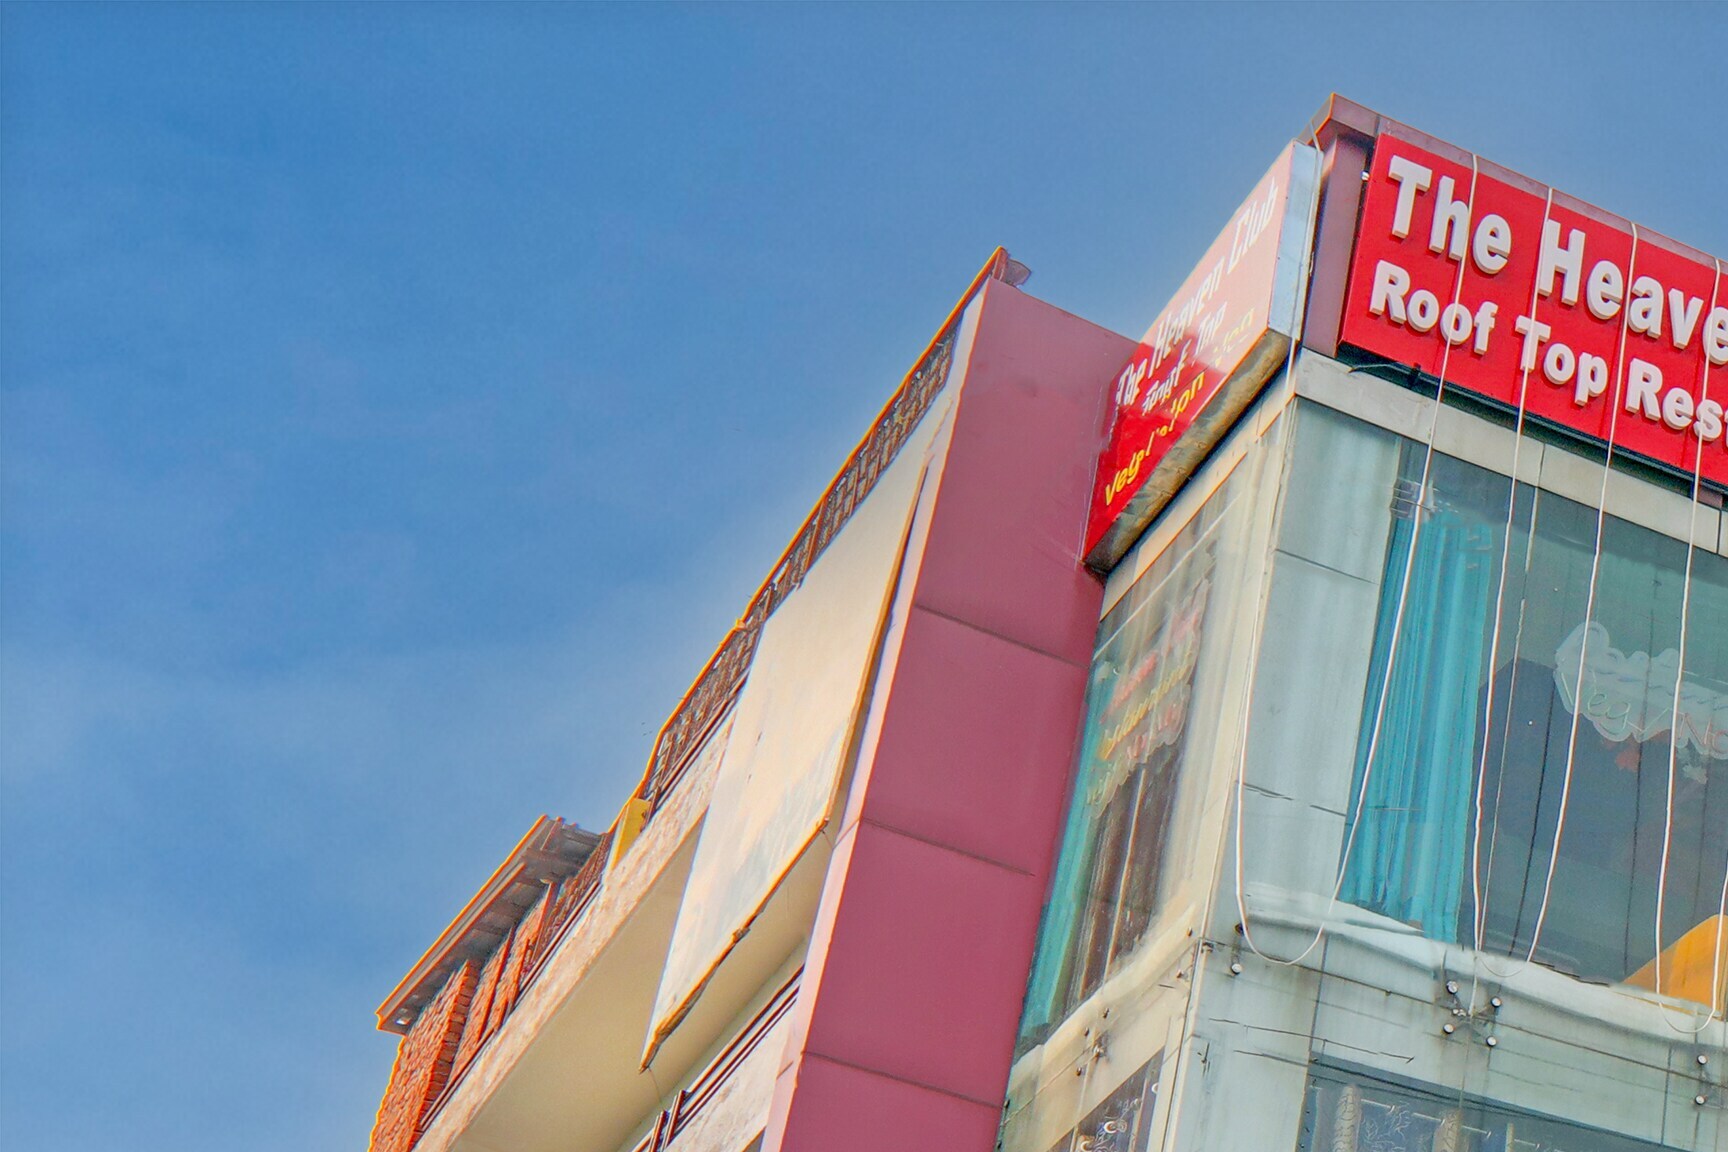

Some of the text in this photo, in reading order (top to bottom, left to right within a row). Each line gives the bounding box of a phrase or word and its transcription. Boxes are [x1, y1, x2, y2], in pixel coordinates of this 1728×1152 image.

[1388, 155, 1511, 274] The
[1370, 260, 1498, 355] Roof
[1515, 315, 1608, 407] Top
